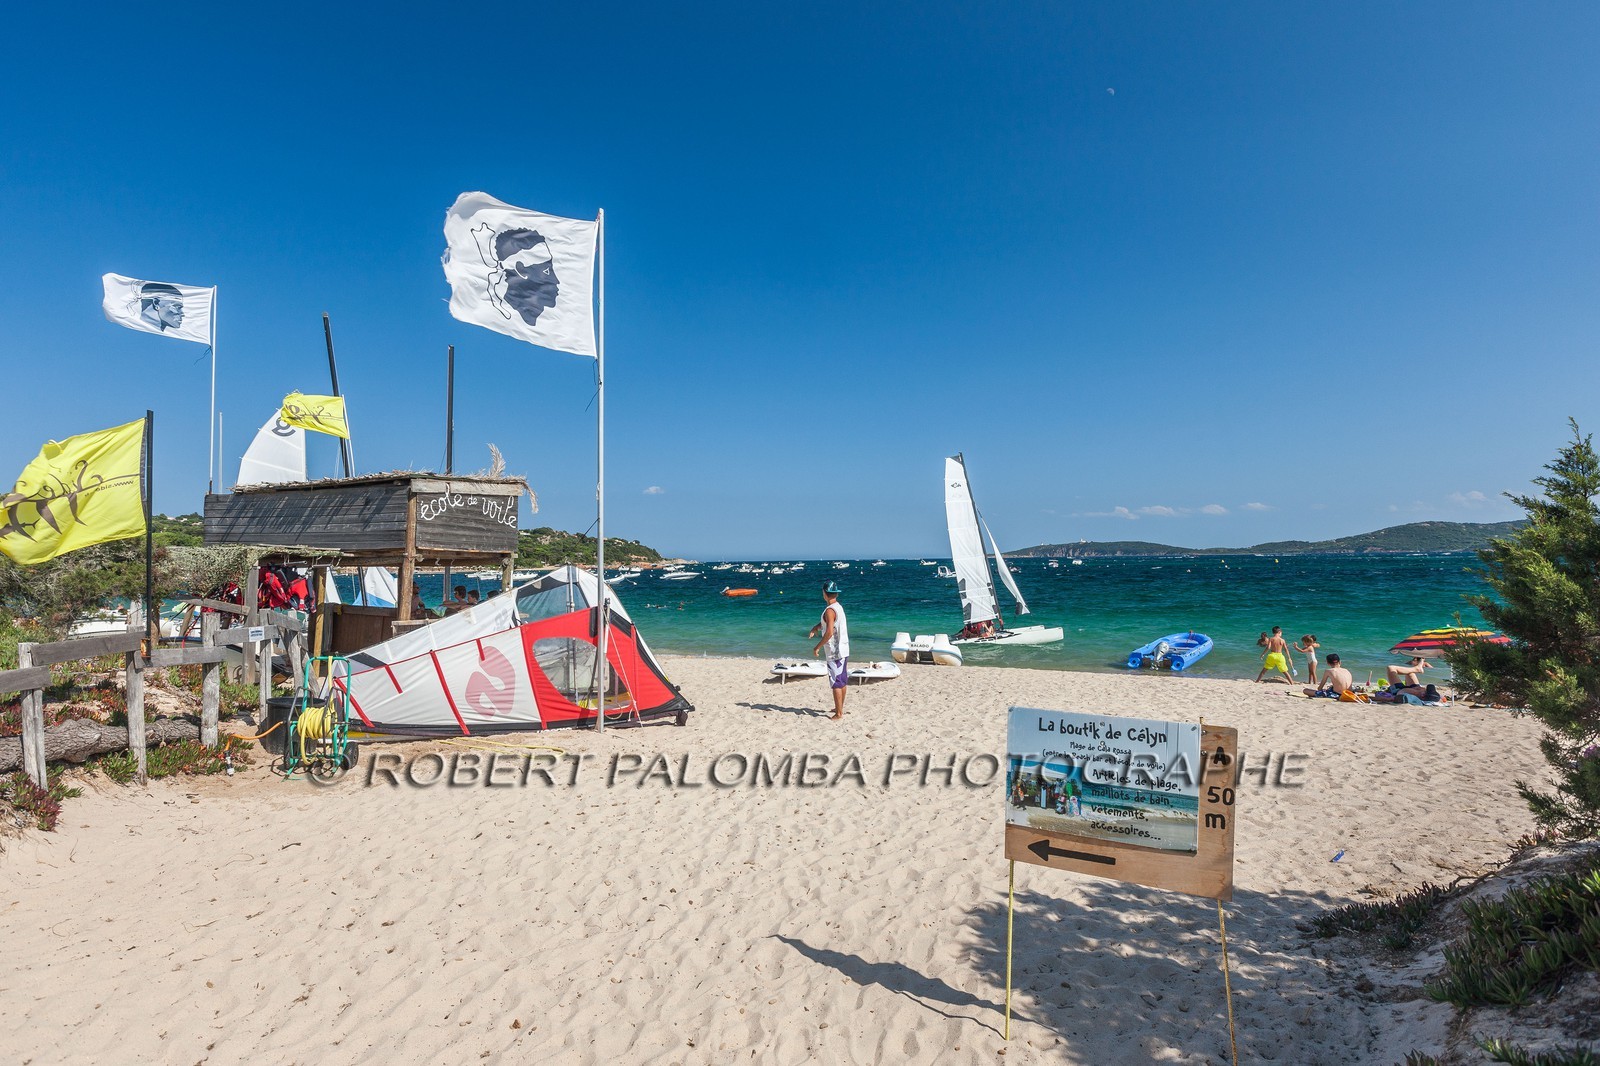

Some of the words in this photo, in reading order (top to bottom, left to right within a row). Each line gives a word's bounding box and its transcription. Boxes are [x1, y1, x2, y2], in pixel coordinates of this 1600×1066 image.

[420, 483, 464, 520] école
[467, 495, 478, 505] de
[482, 495, 517, 528] voile
[1038, 717, 1055, 732] La
[1060, 719, 1100, 740] boutik
[1105, 724, 1122, 740] de
[1127, 727, 1168, 748] Célyn
[1069, 741, 1086, 752] Plage
[1137, 760, 1145, 768] de
[1213, 746, 1227, 766] A
[1092, 769, 1131, 784] Articles
[1135, 774, 1147, 786] de
[1091, 788, 1131, 801] maillots
[1134, 790, 1146, 803] de
[1207, 786, 1235, 806] 50
[1205, 813, 1226, 830] m
